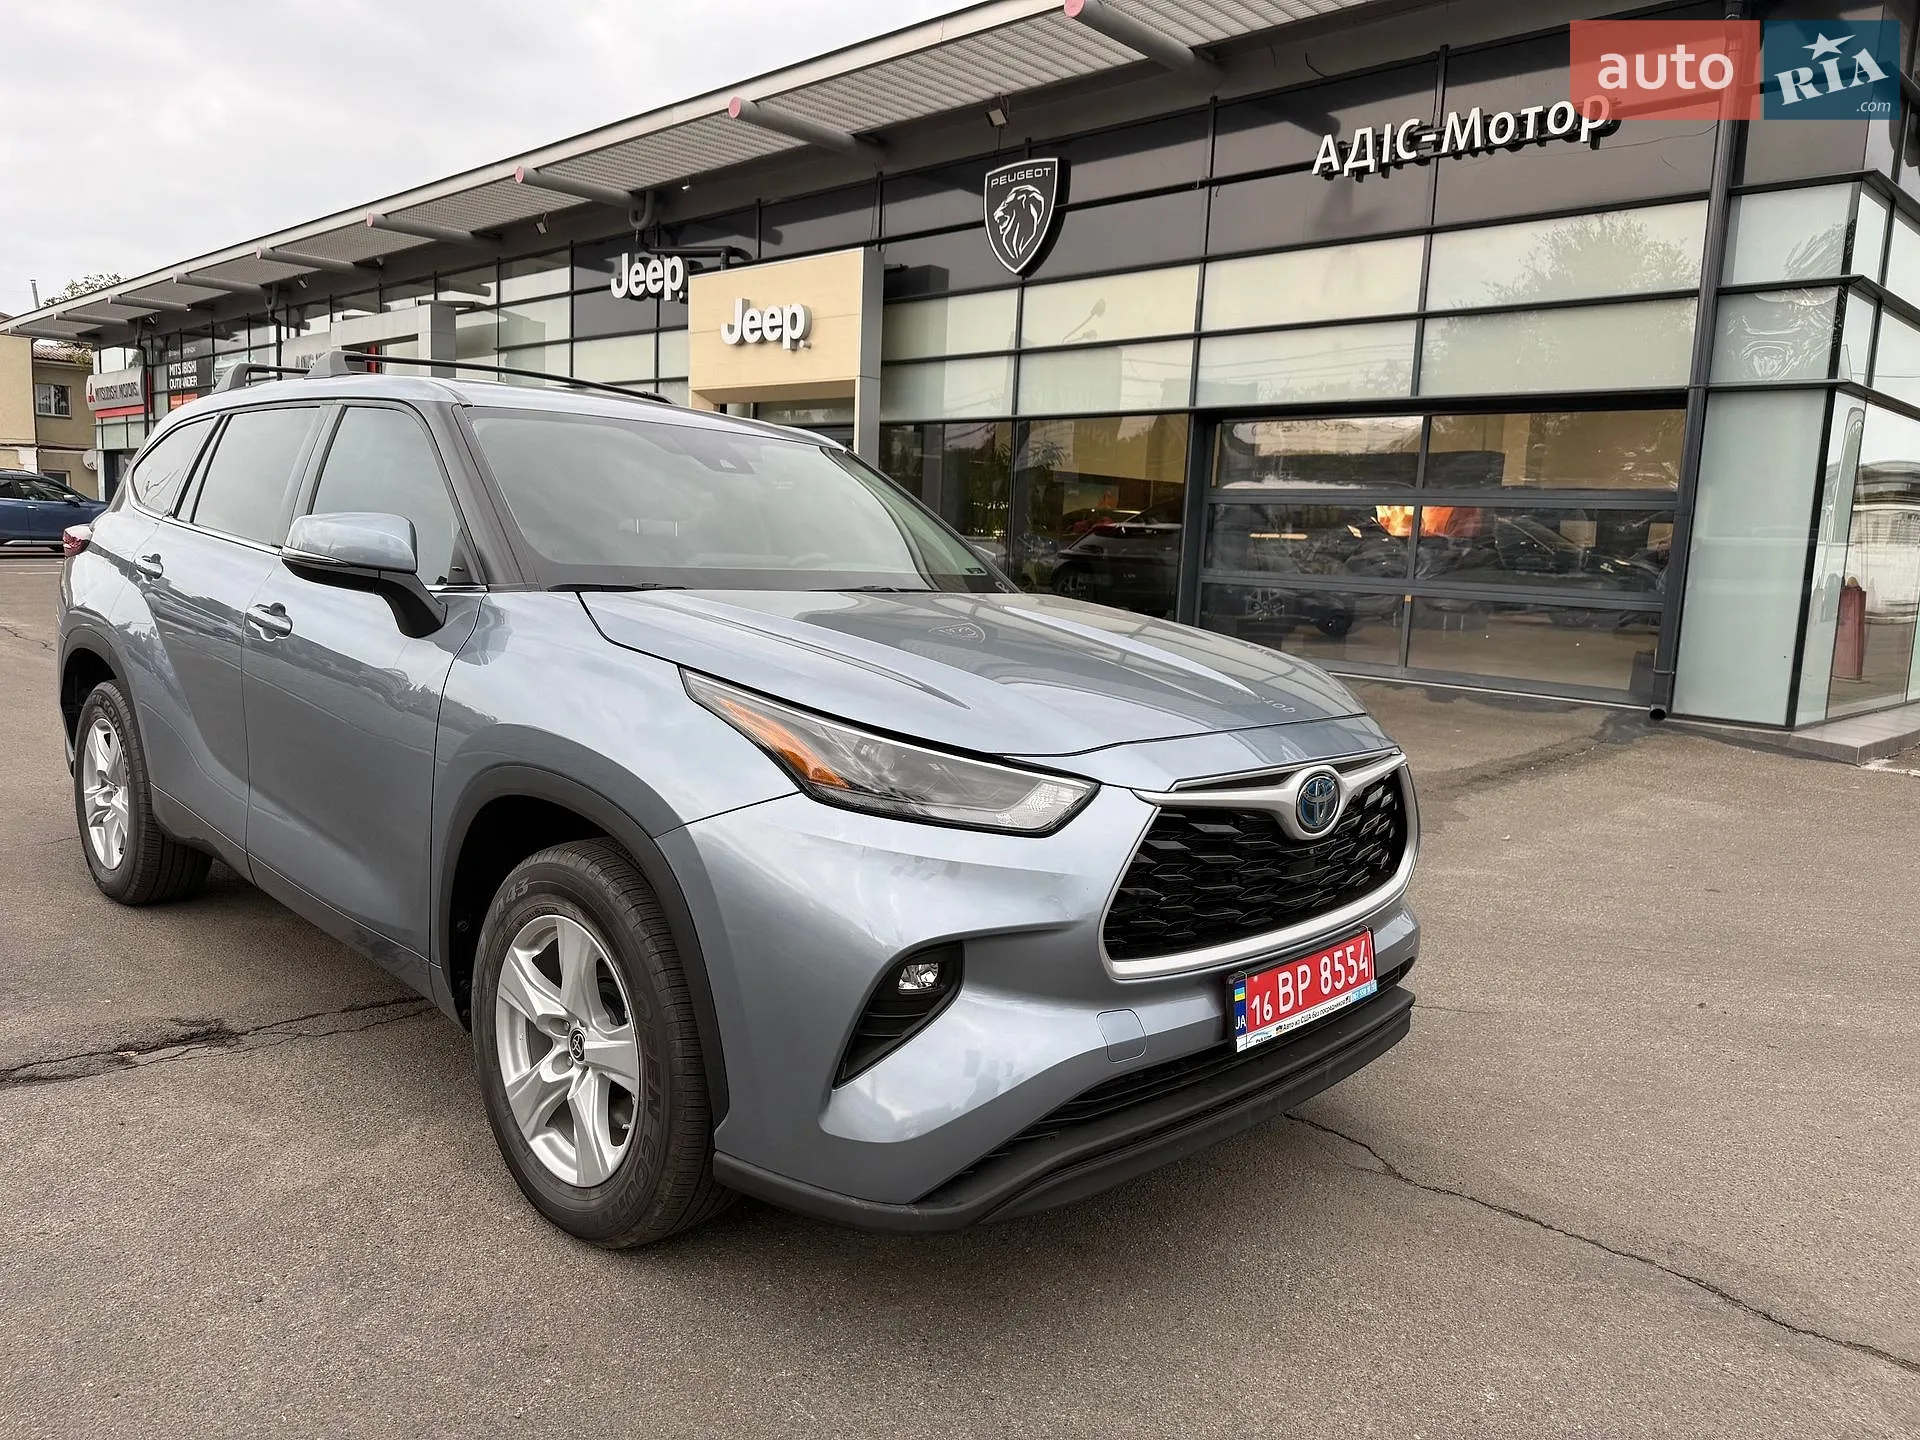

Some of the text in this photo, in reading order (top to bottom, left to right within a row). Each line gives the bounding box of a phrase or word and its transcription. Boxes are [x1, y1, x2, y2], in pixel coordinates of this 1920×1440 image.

[1311, 94, 1611, 177] АДІС-Мотор
[991, 167, 1052, 189] PEUGEOT
[1250, 990, 1273, 1026] 16
[1319, 940, 1370, 996] 8554
